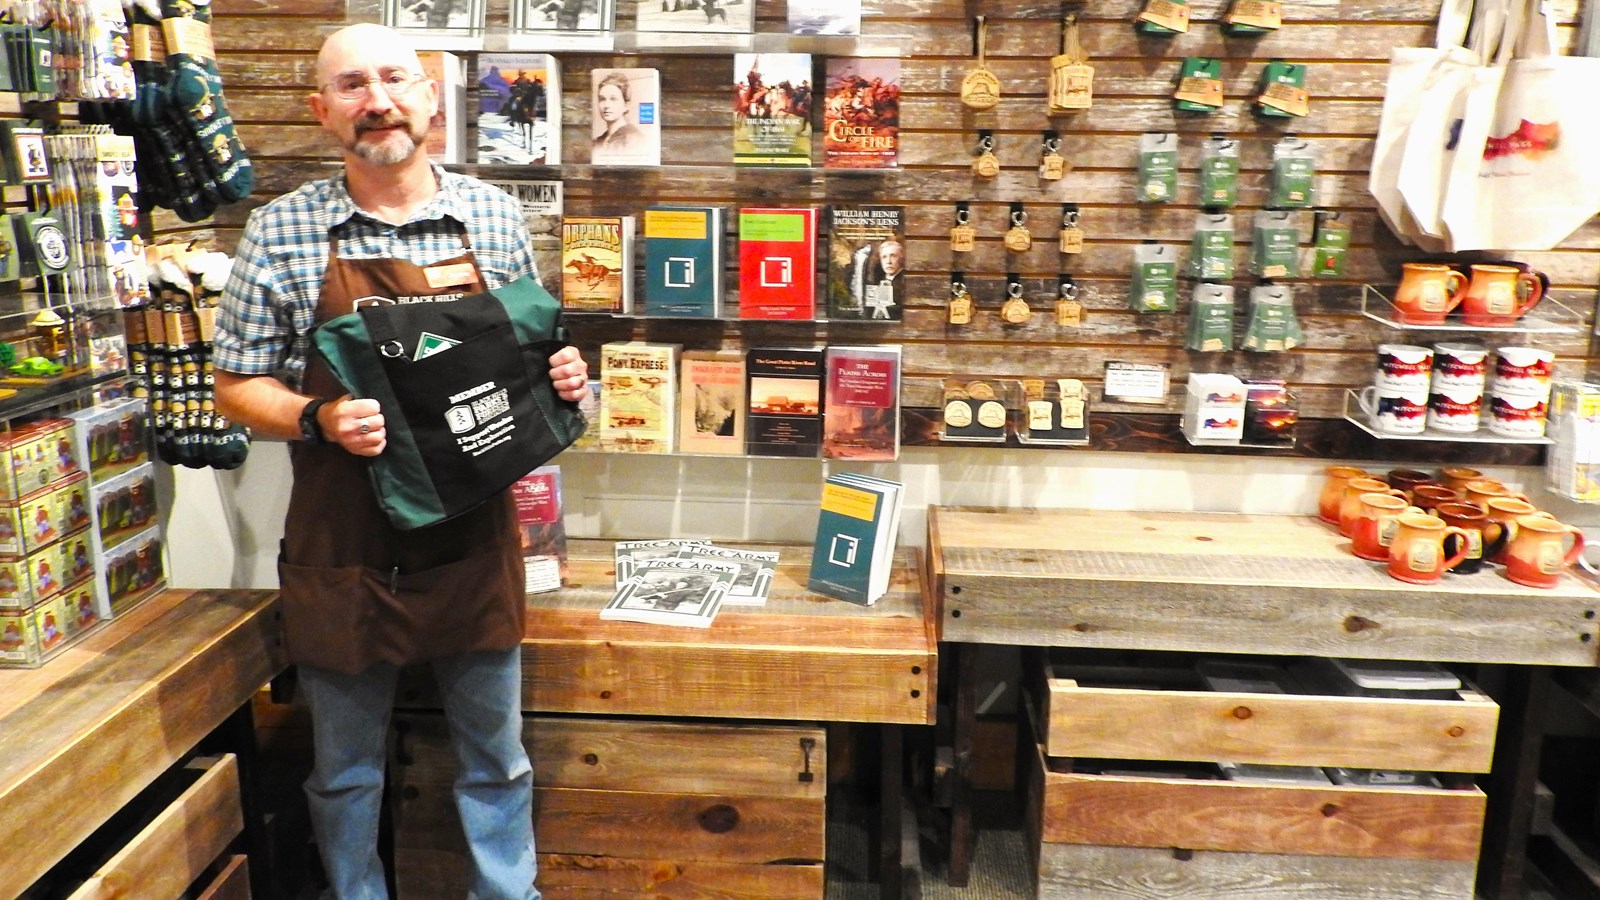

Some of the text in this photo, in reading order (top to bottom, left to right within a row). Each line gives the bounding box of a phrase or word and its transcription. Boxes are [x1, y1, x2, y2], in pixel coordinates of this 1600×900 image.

[829, 119, 875, 142] CIRCLE
[860, 136, 895, 148] FIRE
[517, 184, 558, 203] WOMEN
[871, 210, 899, 218] HENRY
[833, 217, 899, 226] JACKSON'S LENS
[563, 224, 619, 245] ORPHANS
[397, 296, 433, 305] BLACK
[608, 357, 664, 371] PONY EXPRESS
[689, 545, 776, 561] TREE ARMY
[689, 563, 736, 573] ARMY
